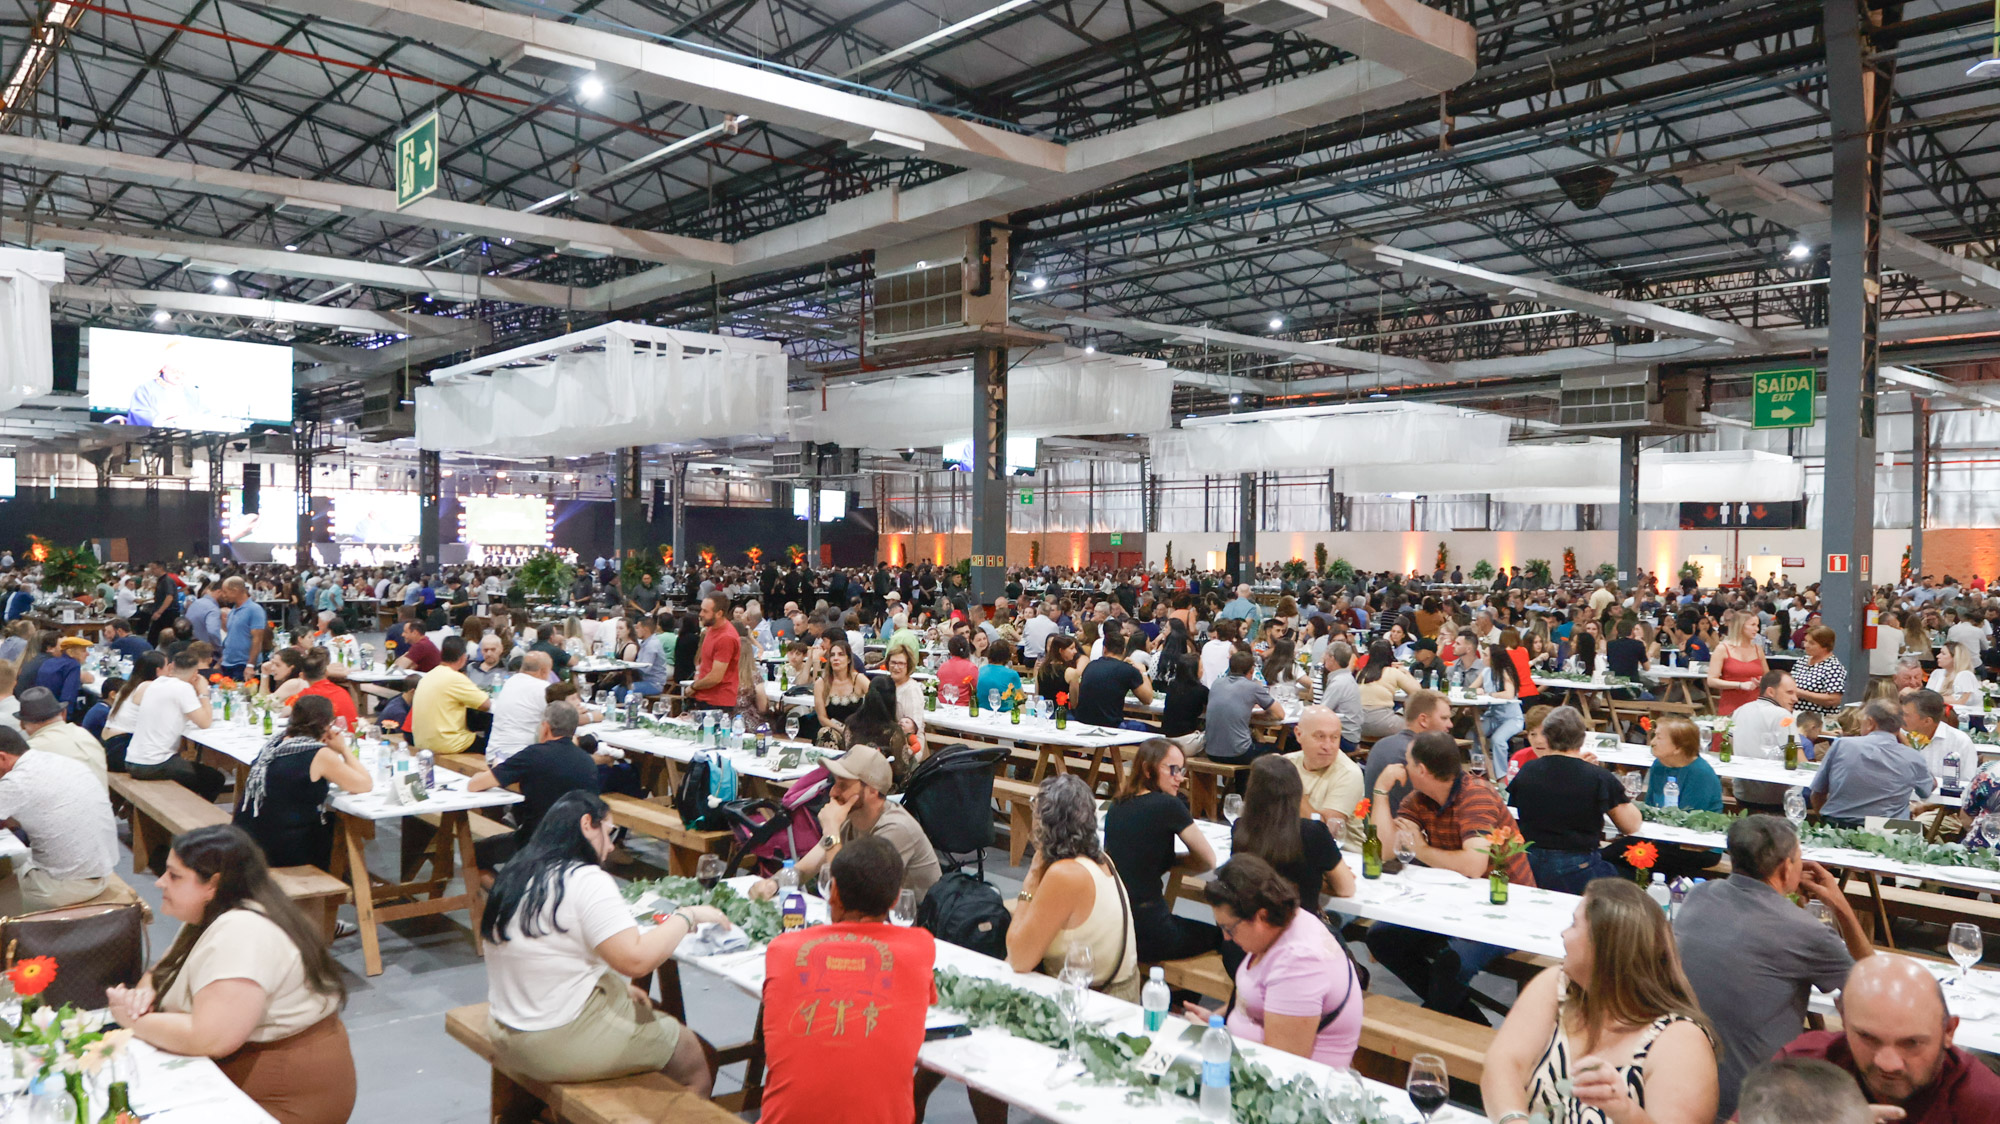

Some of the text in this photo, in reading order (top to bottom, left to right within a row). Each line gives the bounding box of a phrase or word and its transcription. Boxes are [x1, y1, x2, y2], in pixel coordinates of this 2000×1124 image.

[1757, 374, 1810, 393] SAÍDA
[1771, 393, 1794, 402] EXIT
[1141, 1051, 1172, 1071] 28
